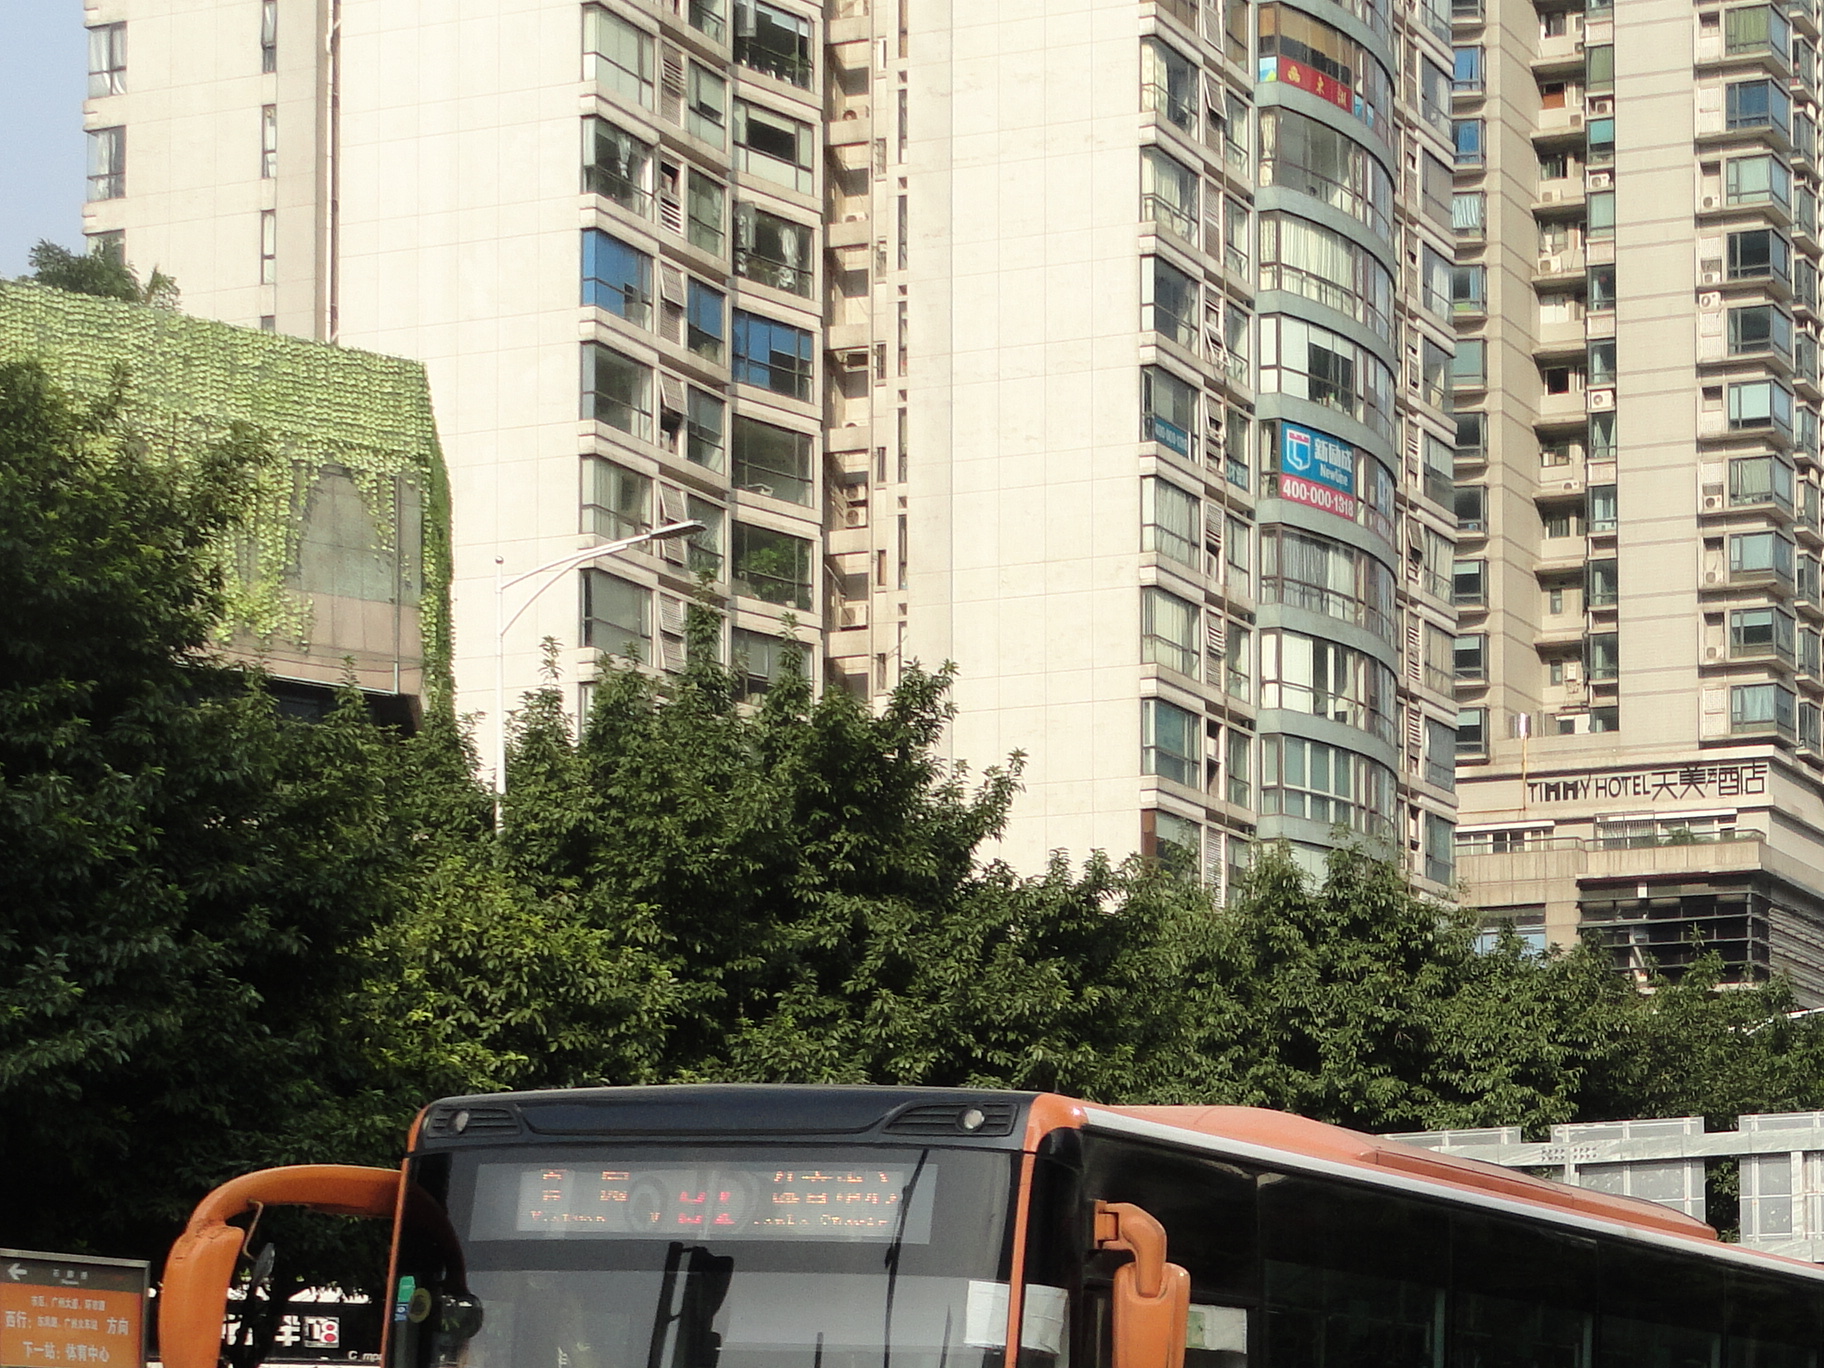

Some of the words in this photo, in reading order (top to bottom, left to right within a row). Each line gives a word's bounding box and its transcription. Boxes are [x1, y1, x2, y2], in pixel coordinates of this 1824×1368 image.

[1527, 772, 1592, 803] TIMMY
[1595, 775, 1652, 799] HOTEL
[1651, 758, 1769, 801] 天美酒店
[106, 1316, 129, 1335] 方向
